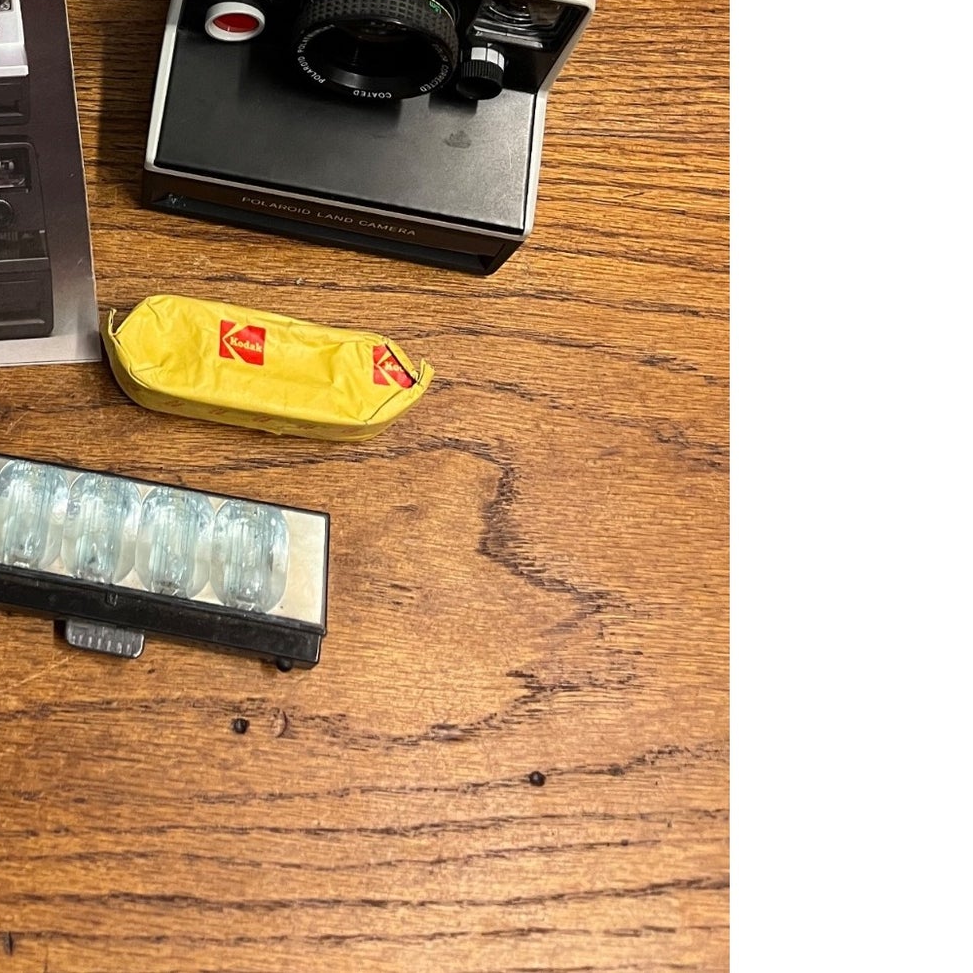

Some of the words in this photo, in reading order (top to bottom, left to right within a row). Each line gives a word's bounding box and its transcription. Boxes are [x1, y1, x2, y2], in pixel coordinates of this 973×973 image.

[298, 56, 326, 83] POLAROID
[353, 90, 392, 99] COATED
[242, 196, 311, 215] POLAROID
[317, 212, 353, 223] LAND
[359, 220, 416, 236] CAMERA
[230, 336, 263, 353] Kodak
